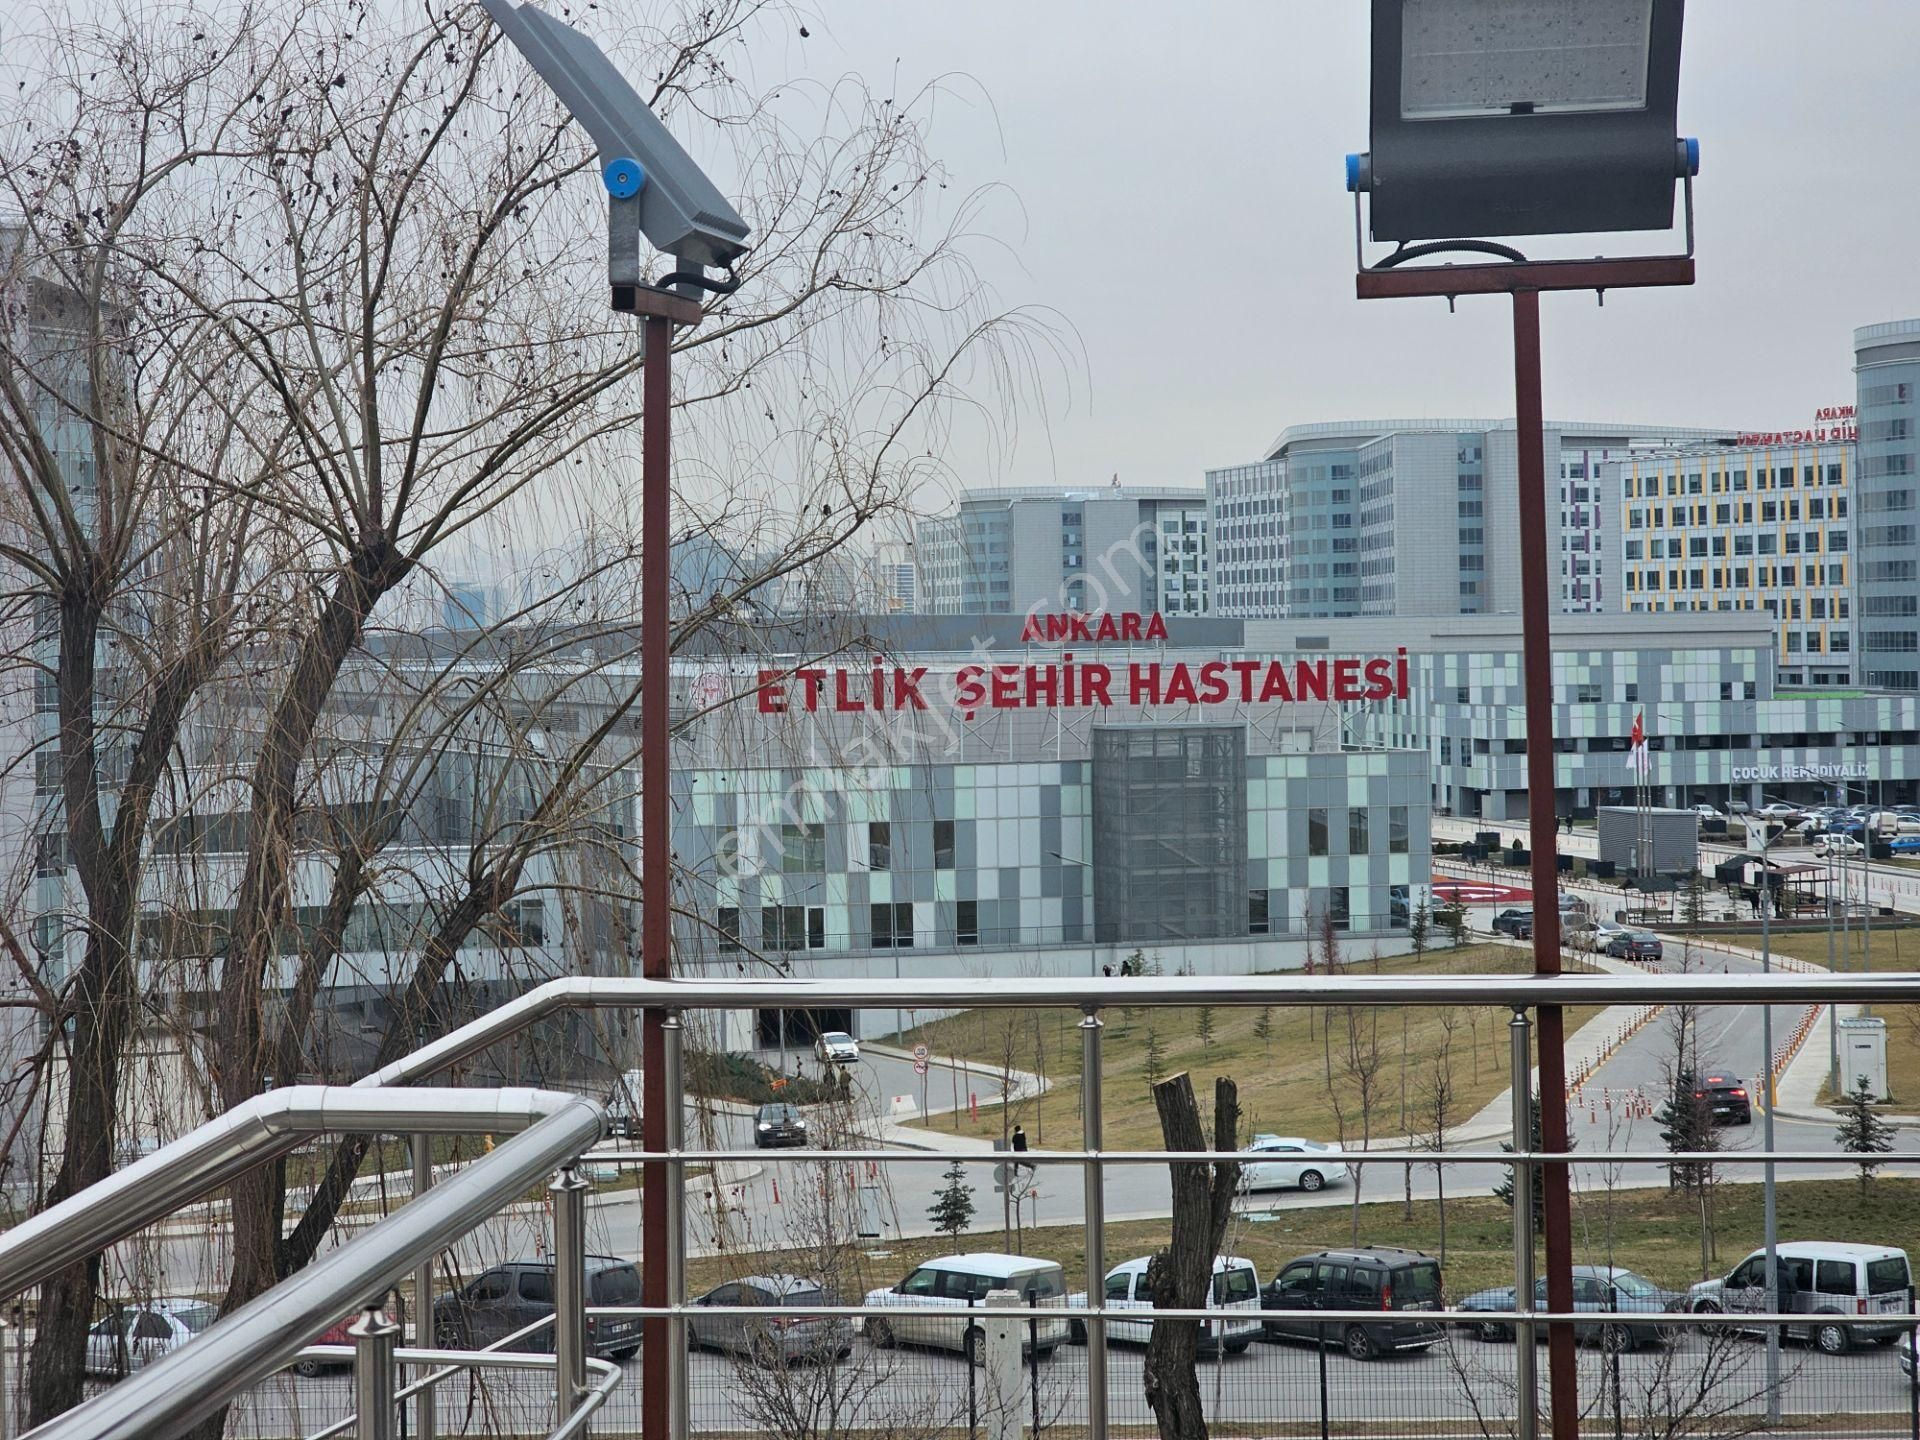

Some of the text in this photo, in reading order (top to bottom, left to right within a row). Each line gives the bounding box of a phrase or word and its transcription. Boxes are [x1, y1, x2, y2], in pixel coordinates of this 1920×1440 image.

[1021, 611, 1169, 642] ANKARA
[758, 647, 1409, 721] ETLİK ŞEHİR HASTANESİ
[1733, 767, 1779, 782] ÇOCUK
